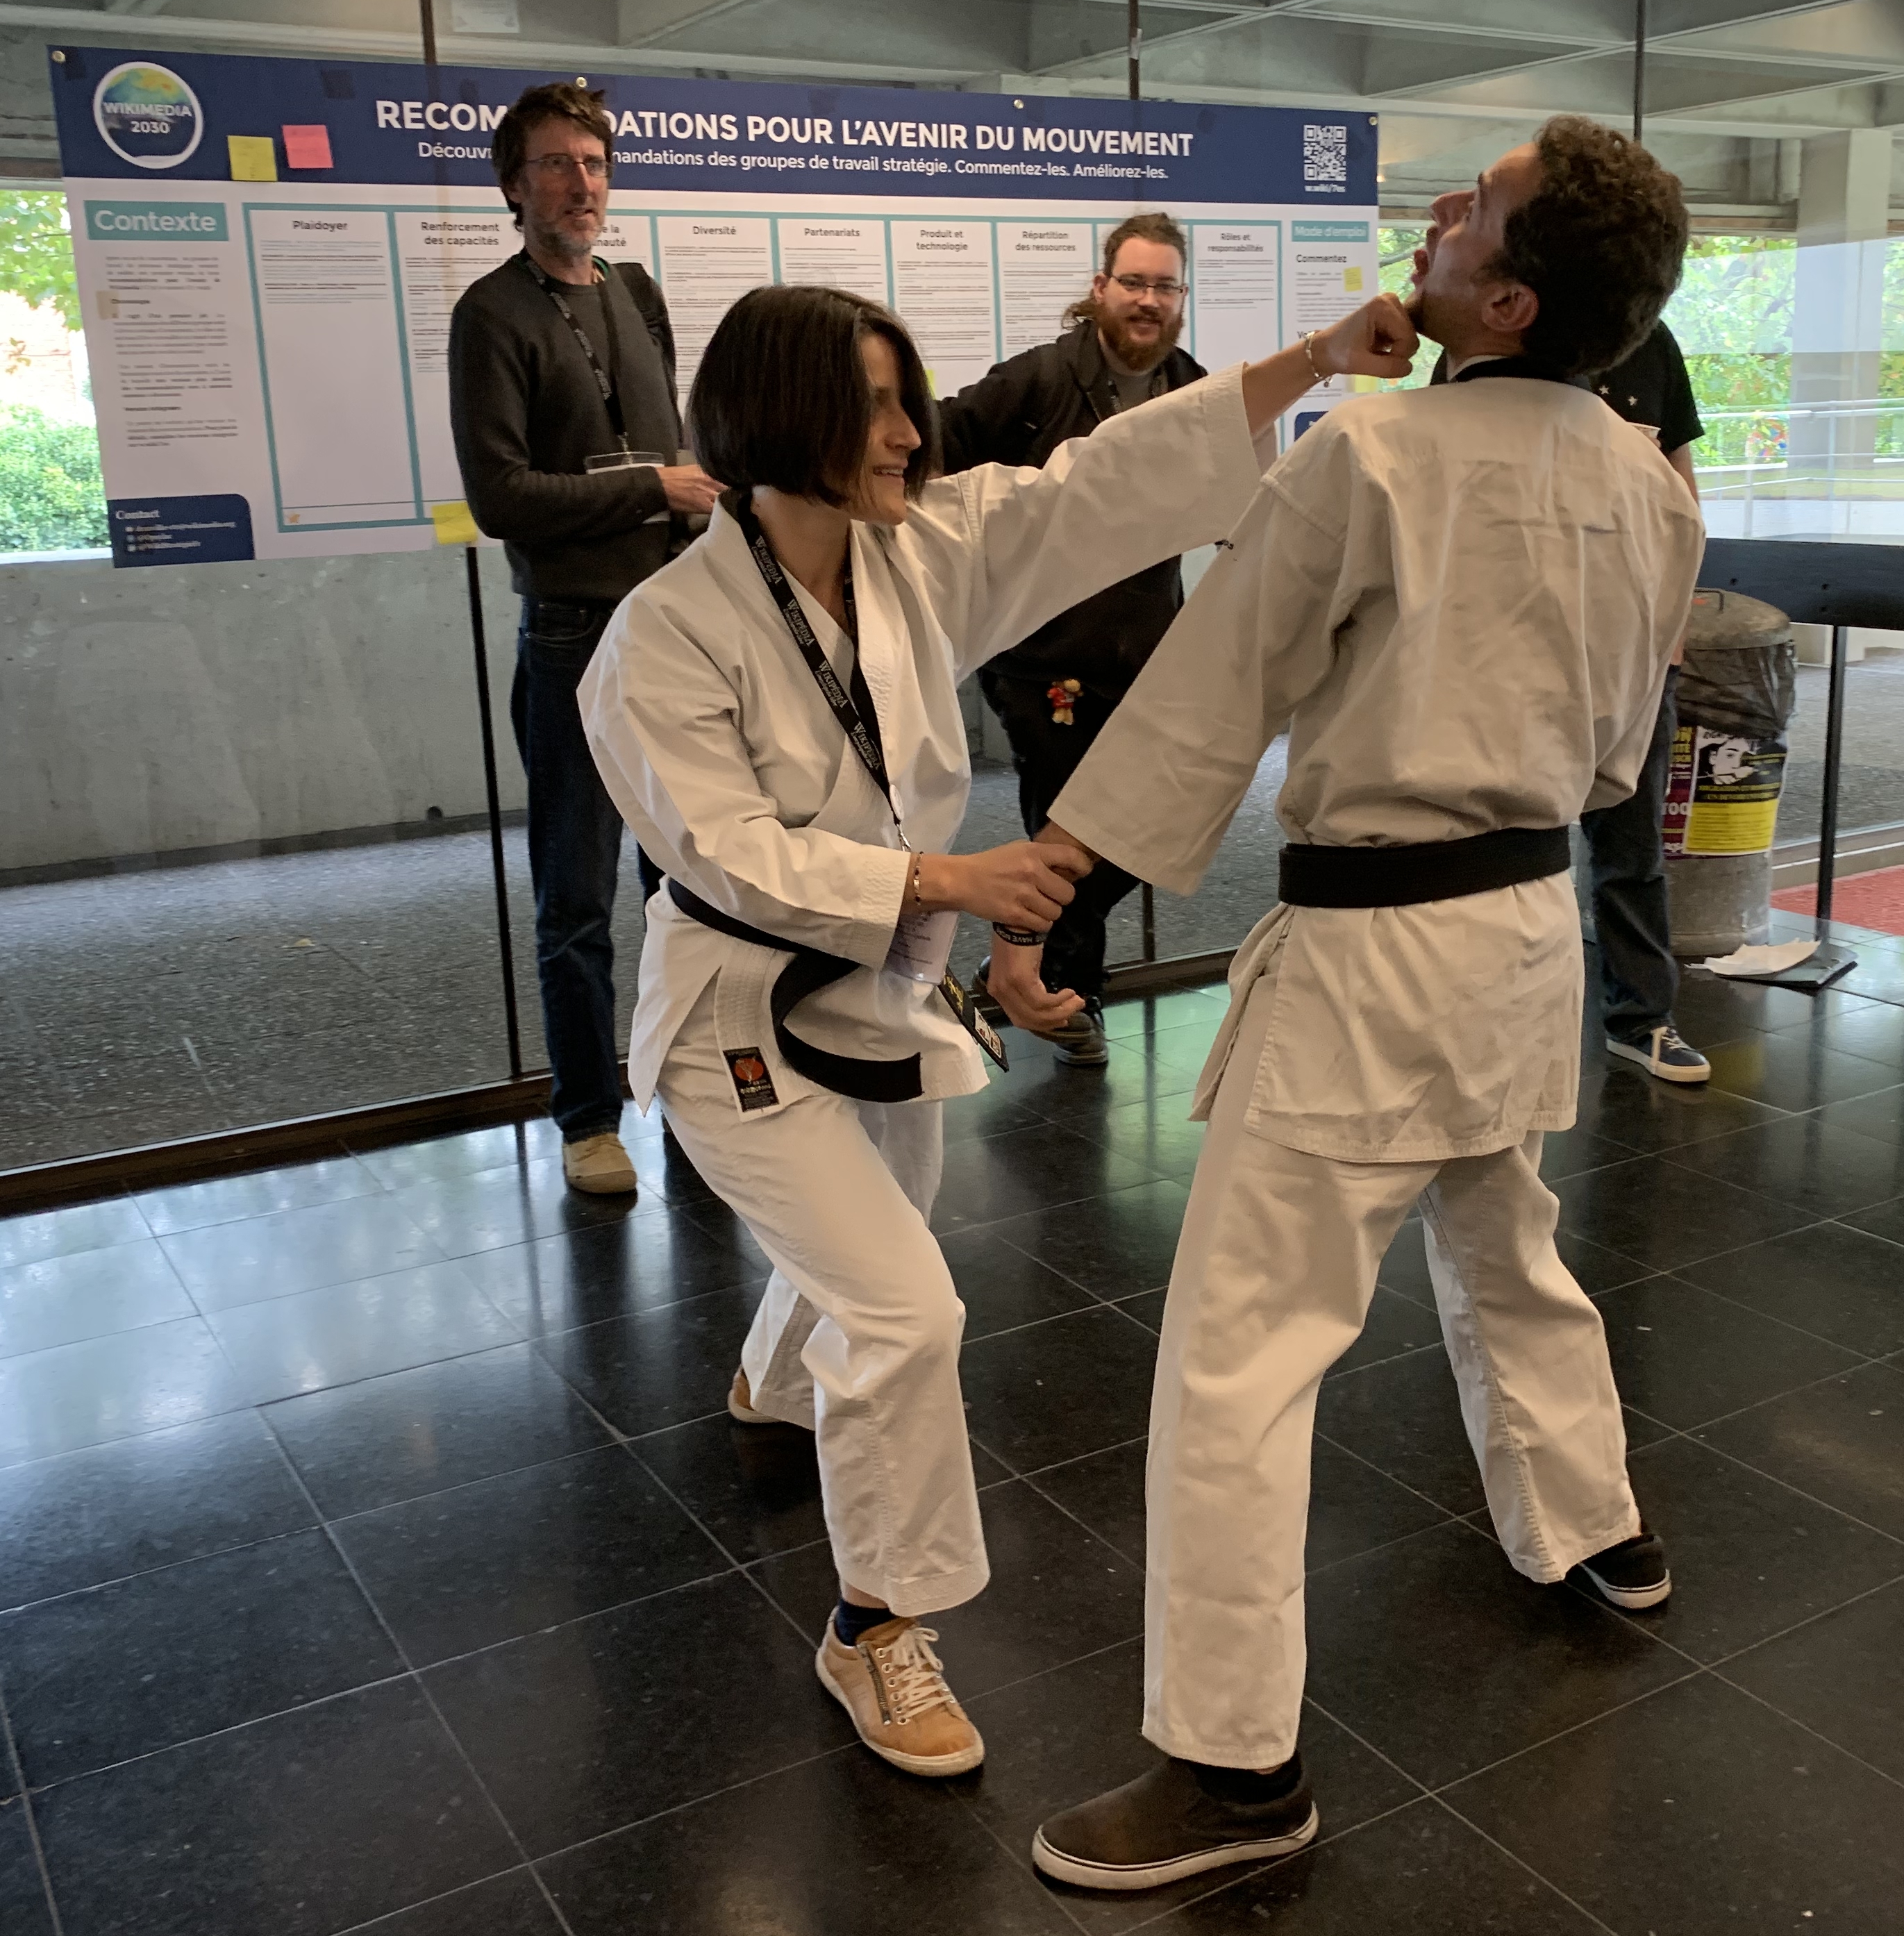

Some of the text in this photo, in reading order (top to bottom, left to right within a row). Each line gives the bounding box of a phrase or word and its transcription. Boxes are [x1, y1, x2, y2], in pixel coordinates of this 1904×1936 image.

[103, 102, 192, 117] WIKIMEDIA
[131, 121, 170, 134] 2030
[376, 99, 738, 141] RECOMATIONS
[747, 115, 833, 144] POUR
[976, 125, 1014, 151] DU
[1023, 127, 1194, 157] MOUVEMENT
[418, 142, 493, 159] Découv
[708, 151, 736, 167] des
[741, 155, 805, 172] groupes
[809, 153, 830, 169] de
[833, 155, 878, 171] travail
[883, 157, 952, 176] stratégie.
[955, 160, 1070, 176] Commentez-les.
[1073, 162, 1169, 179] Améliorez-les.
[94, 210, 217, 232] Contexte
[292, 220, 349, 232] Plaidoyer
[421, 221, 500, 232] Renforcement
[610, 224, 620, 233] la
[692, 224, 737, 235] Diversité
[804, 226, 860, 237] Partenariats
[920, 229, 964, 239] Produit et
[1022, 230, 1069, 241] Répartition
[424, 236, 499, 247] des capacités
[1015, 242, 1076, 252] des ressources
[917, 242, 968, 253] technologie
[1296, 253, 1347, 263] Commentez
